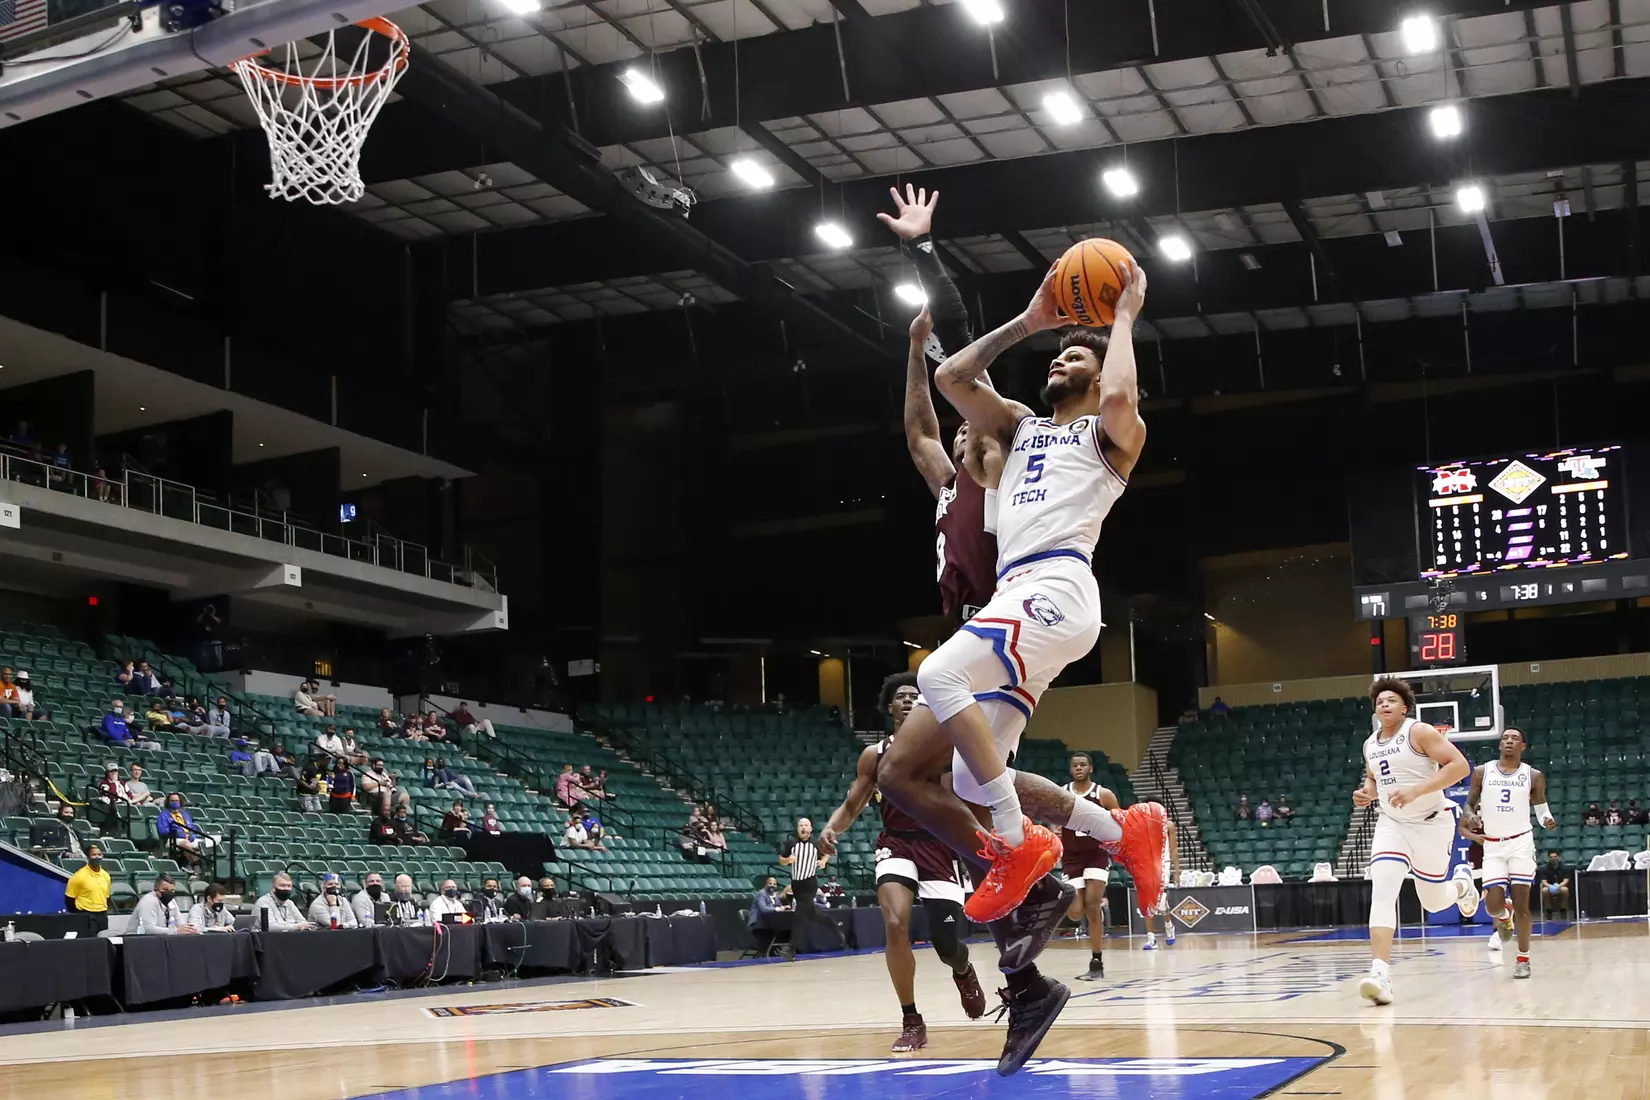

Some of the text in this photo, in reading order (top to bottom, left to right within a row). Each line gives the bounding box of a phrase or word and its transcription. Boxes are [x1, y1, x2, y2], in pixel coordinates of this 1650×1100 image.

[1070, 273, 1094, 325] Wilson
[1024, 453, 1047, 485] 5
[1012, 488, 1048, 507] TECH
[1510, 583, 1538, 600] 7:38
[1372, 601, 1386, 617] 17
[1427, 614, 1457, 629] 7:38
[1369, 746, 1401, 760] LOUISIANA
[1378, 759, 1391, 776] 2
[1380, 776, 1397, 786] TECH
[1488, 779, 1525, 788] LOUISIANA
[1500, 789, 1511, 804] 3
[1496, 805, 1514, 813] TECH
[1181, 908, 1202, 916] NIT
